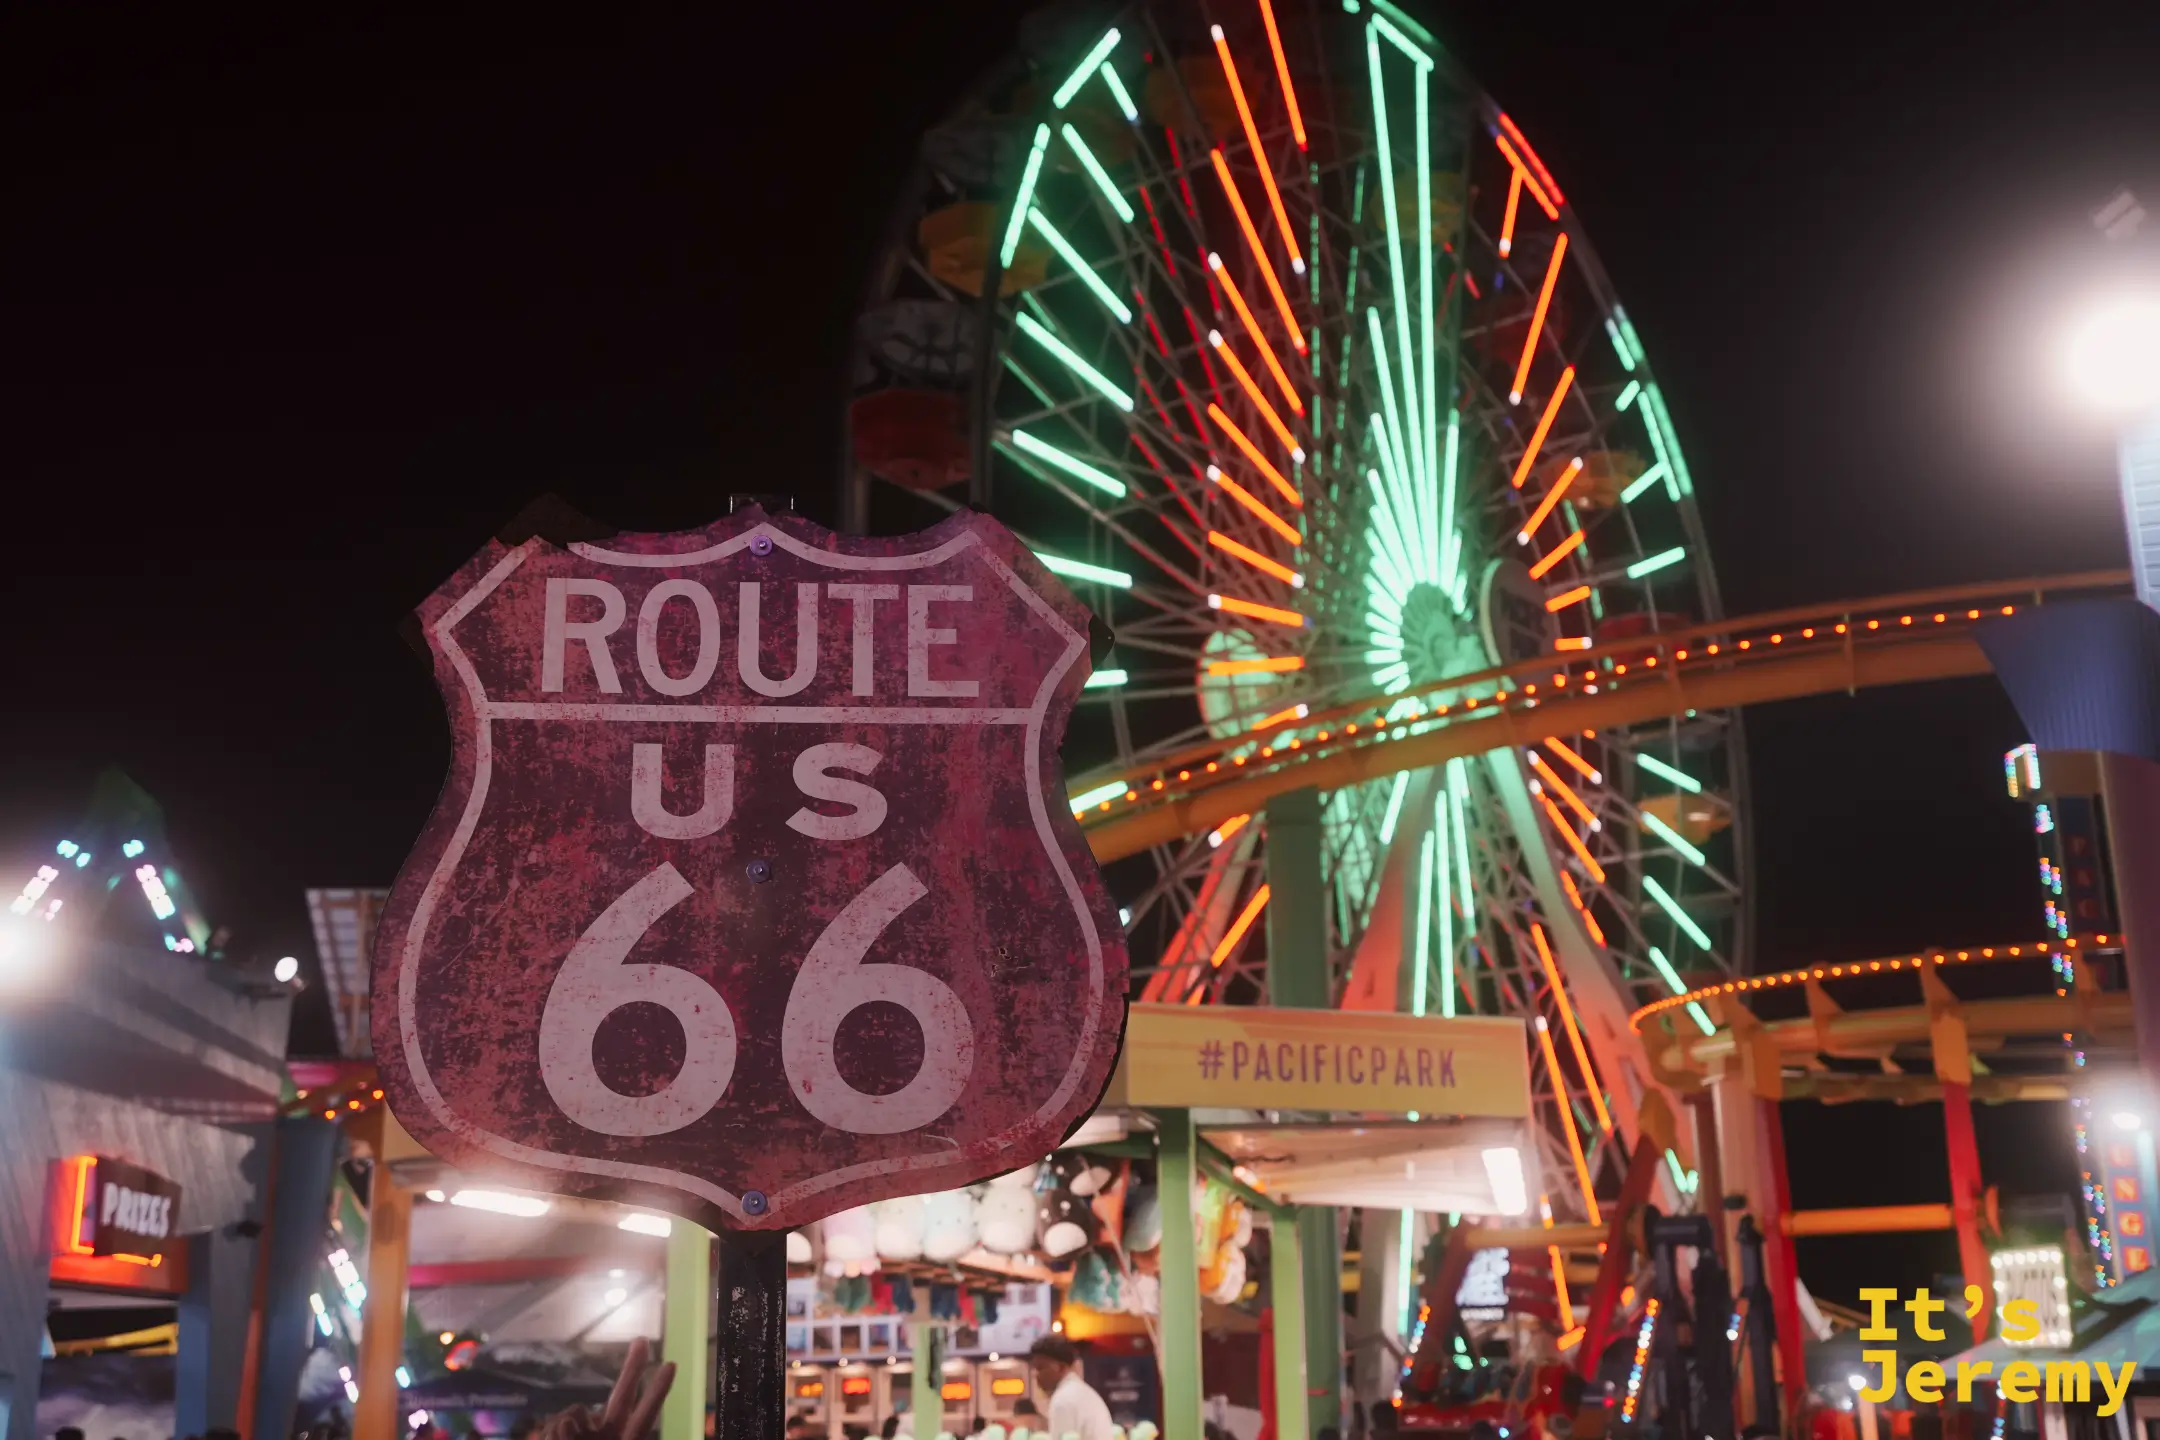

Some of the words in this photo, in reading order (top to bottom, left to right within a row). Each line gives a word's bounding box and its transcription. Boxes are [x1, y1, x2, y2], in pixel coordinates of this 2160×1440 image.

[541, 577, 980, 697] ROUTE
[538, 861, 975, 1138] 66
[1197, 1039, 1456, 1088] #PACIFICPARK
[102, 1181, 172, 1239] PRIZES
